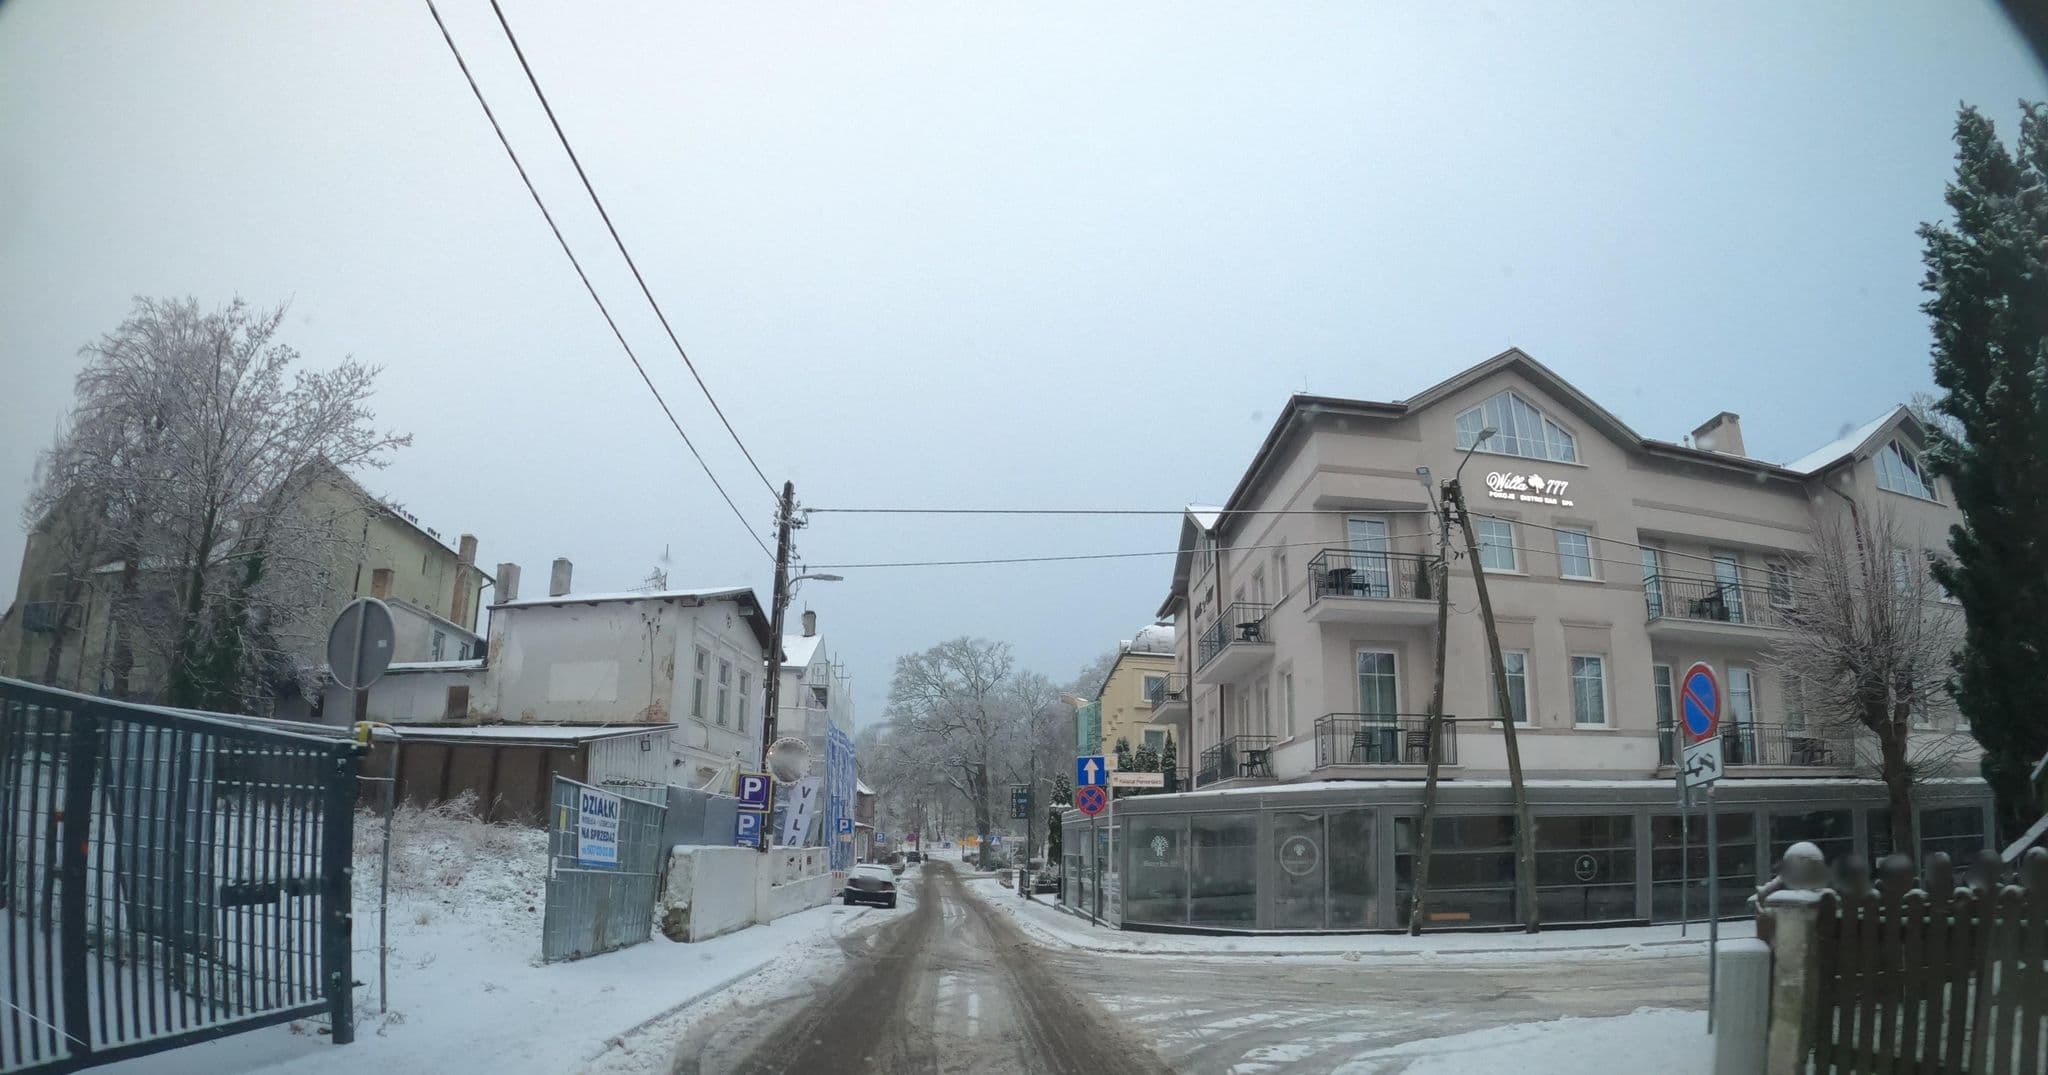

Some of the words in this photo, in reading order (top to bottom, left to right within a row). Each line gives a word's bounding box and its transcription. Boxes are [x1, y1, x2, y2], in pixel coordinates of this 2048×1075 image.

[1486, 471, 1528, 492] Willa
[1546, 479, 1569, 496] 777
[1489, 491, 1515, 499] POKOJE
[1520, 494, 1543, 503] BISTRO
[744, 777, 762, 800] P
[582, 793, 618, 819] DZIAŁKI
[581, 827, 590, 839] NA
[738, 814, 755, 835] P
[840, 819, 849, 832] P
